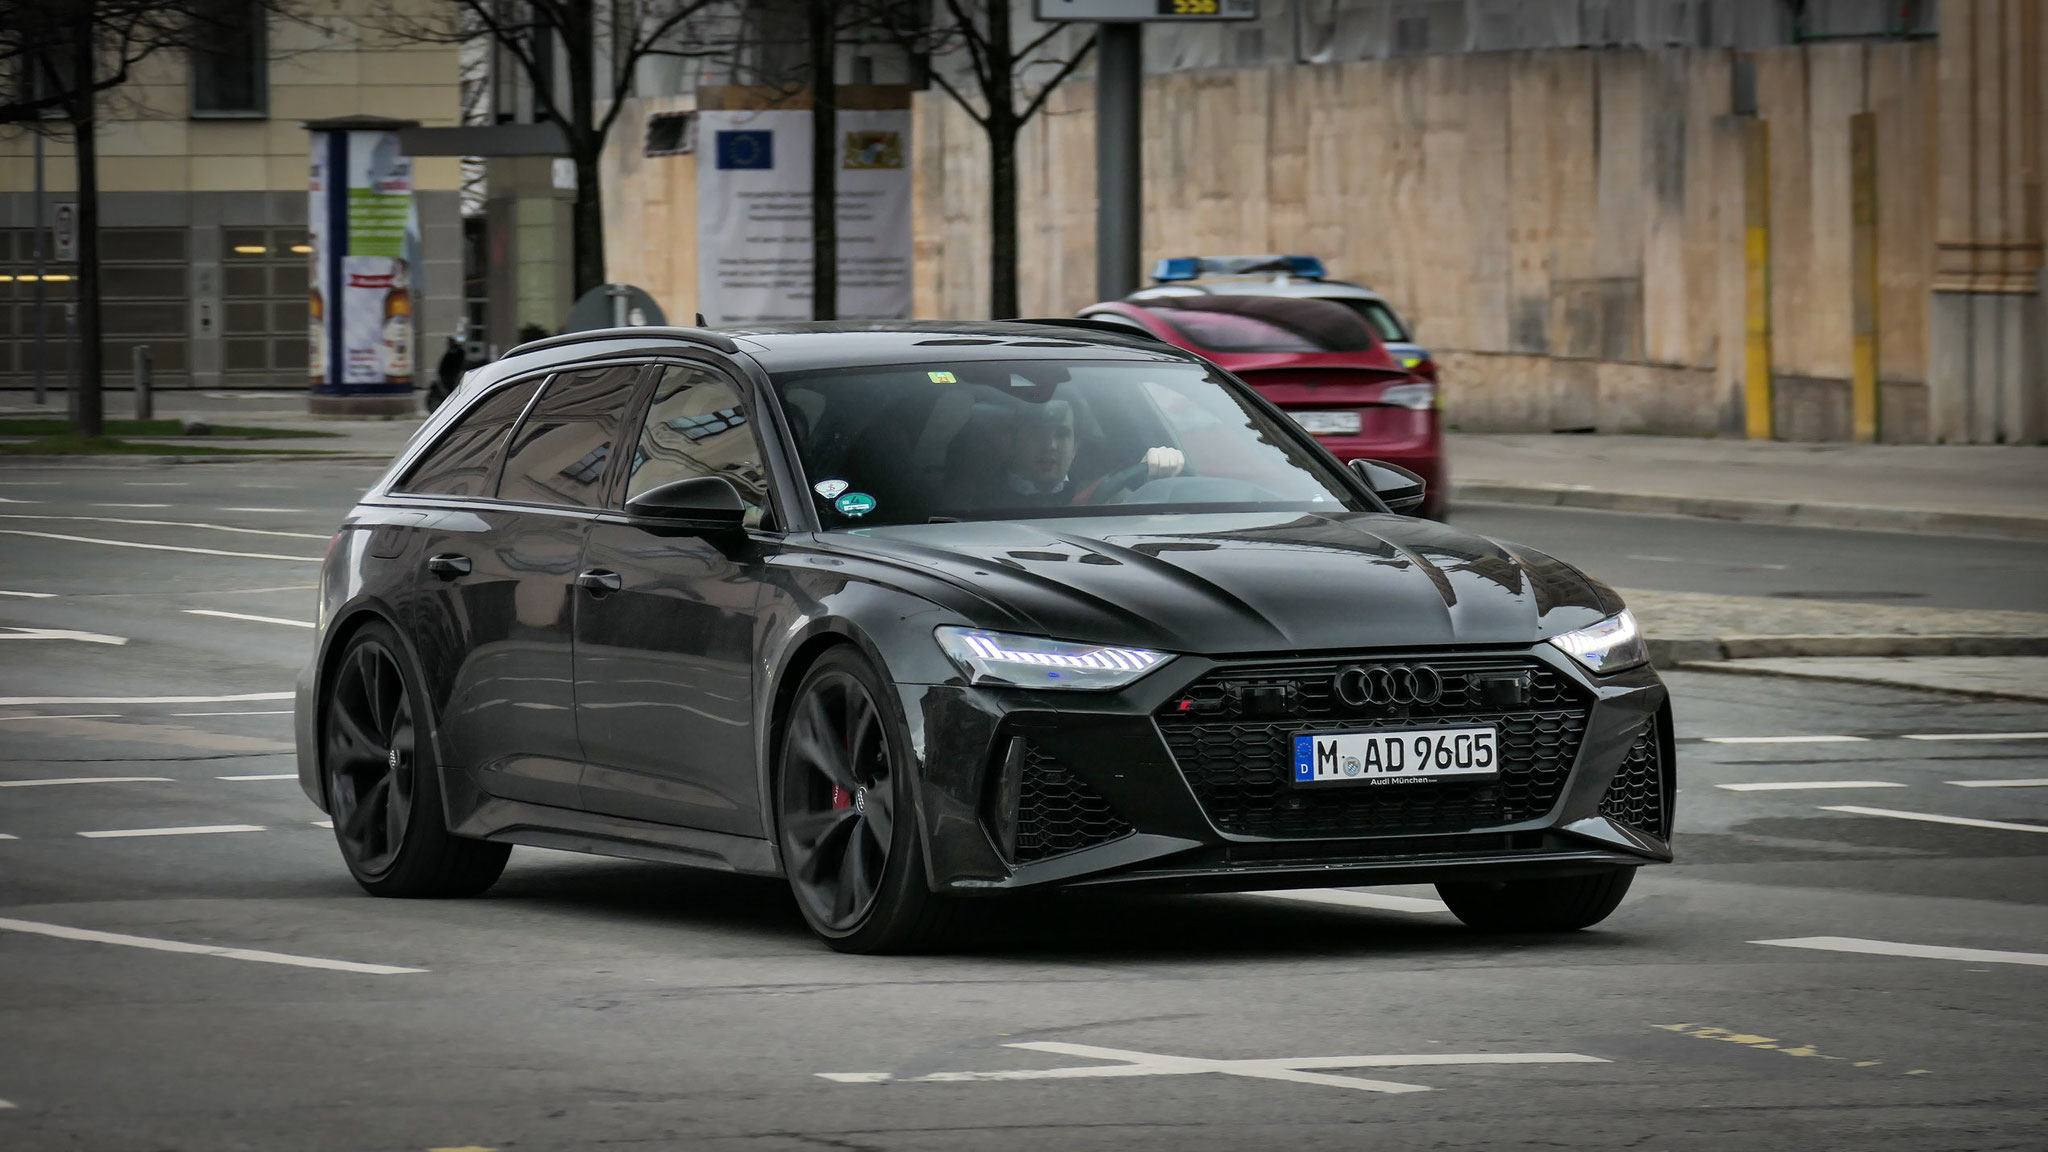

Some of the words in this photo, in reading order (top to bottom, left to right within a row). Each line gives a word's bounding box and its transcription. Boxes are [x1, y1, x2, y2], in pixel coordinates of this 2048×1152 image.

[1317, 740, 1338, 775] M
[1364, 738, 1404, 773] AD
[1414, 733, 1493, 769] 9605
[1301, 763, 1308, 774] D
[1391, 776, 1428, 784] München
